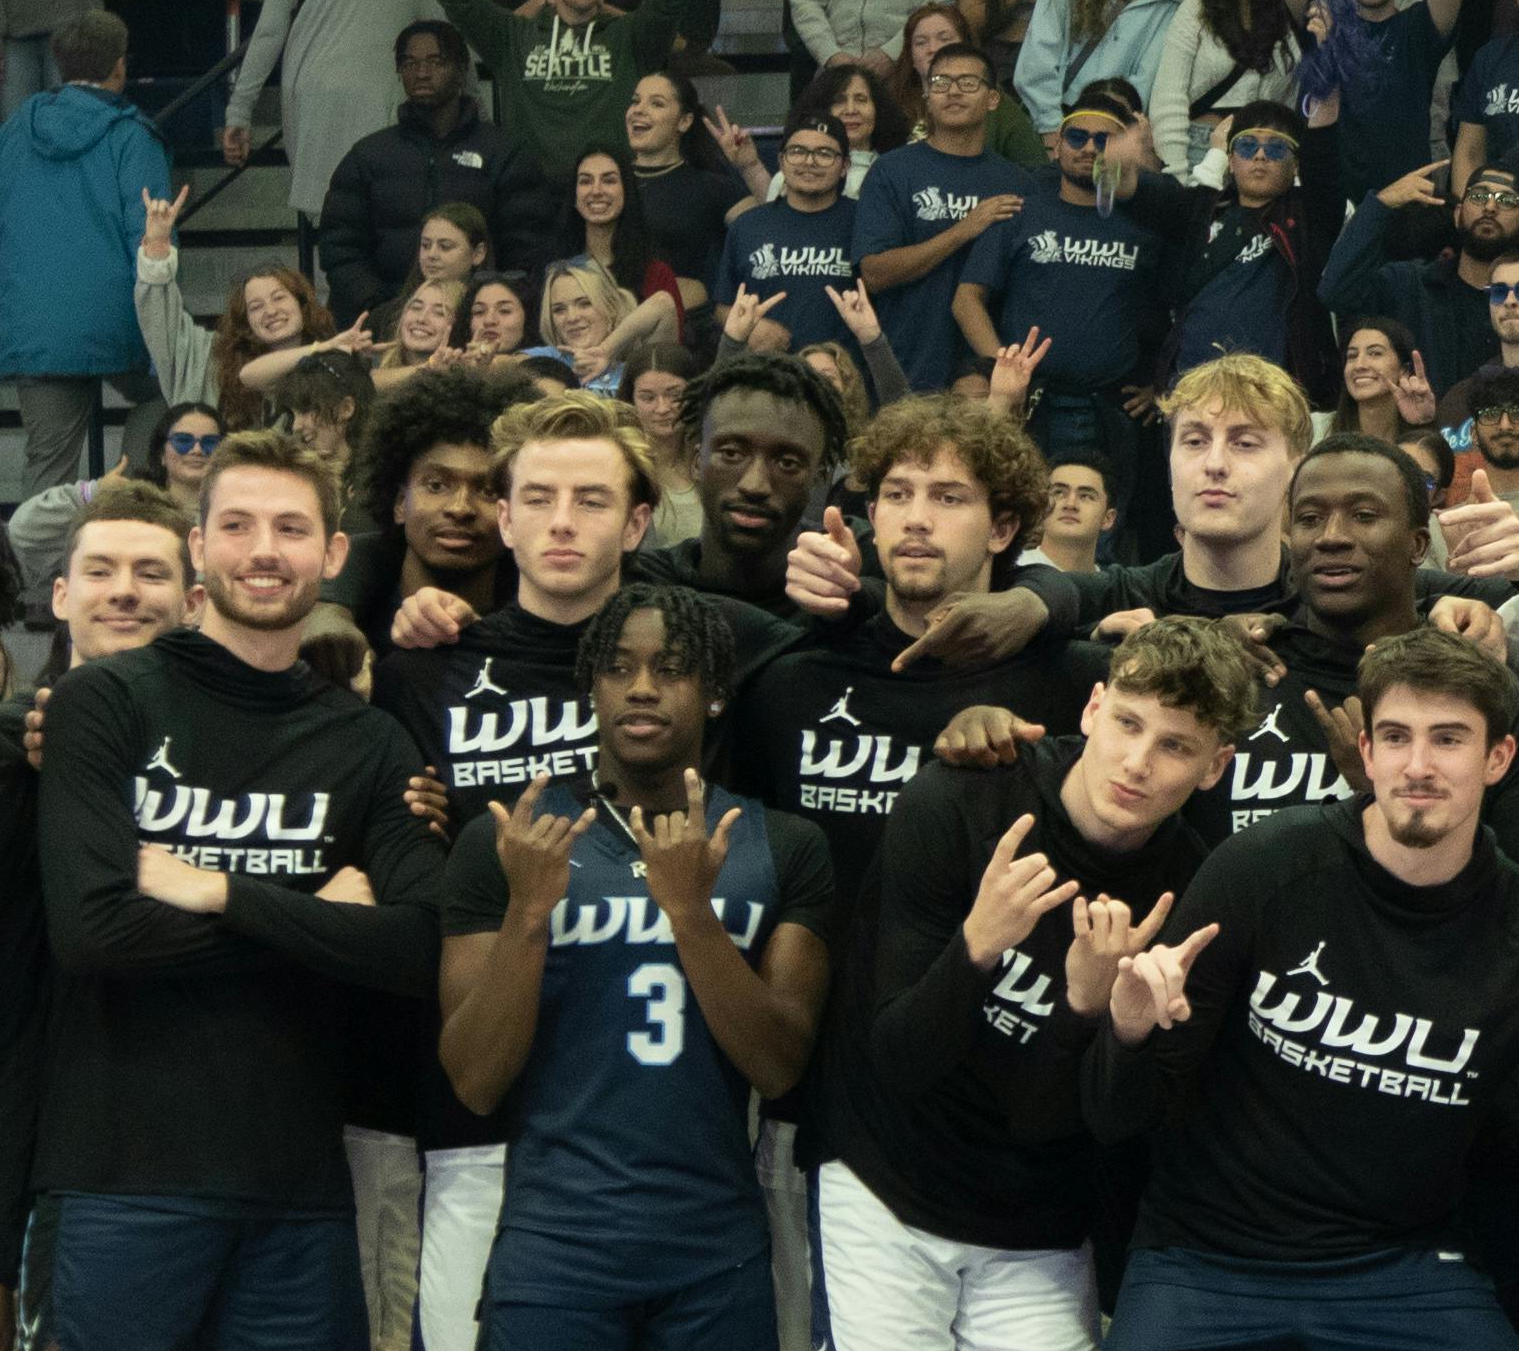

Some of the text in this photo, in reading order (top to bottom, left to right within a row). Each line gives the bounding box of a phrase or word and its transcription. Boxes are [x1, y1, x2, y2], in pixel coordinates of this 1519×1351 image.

[524, 52, 613, 80] SEATTLE
[780, 262, 853, 278] VIKINGS
[1062, 252, 1135, 271] VIKINGS
[1064, 236, 1138, 259] WWU
[448, 696, 600, 754] WW
[451, 746, 600, 788] BASKET
[135, 775, 330, 841] WWU
[626, 963, 686, 1067] 3
[1249, 970, 1481, 1075] WWU
[1247, 1010, 1471, 1106] BASKETBALL
